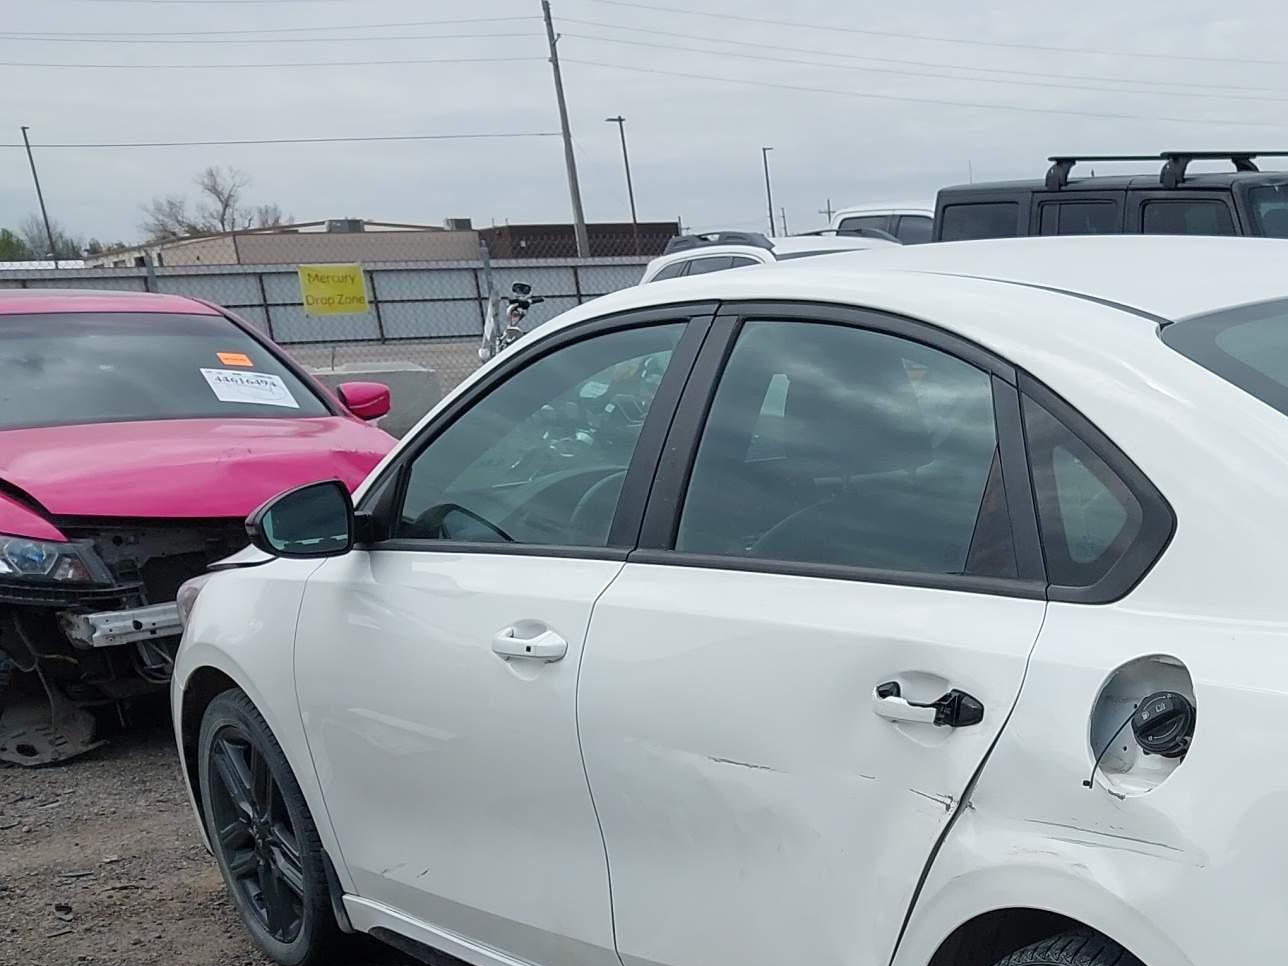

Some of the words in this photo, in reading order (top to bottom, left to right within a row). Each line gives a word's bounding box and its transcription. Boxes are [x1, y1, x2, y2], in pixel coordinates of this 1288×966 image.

[307, 273, 356, 284] Mercury
[305, 294, 335, 307] Drop
[337, 294, 365, 305] Zone
